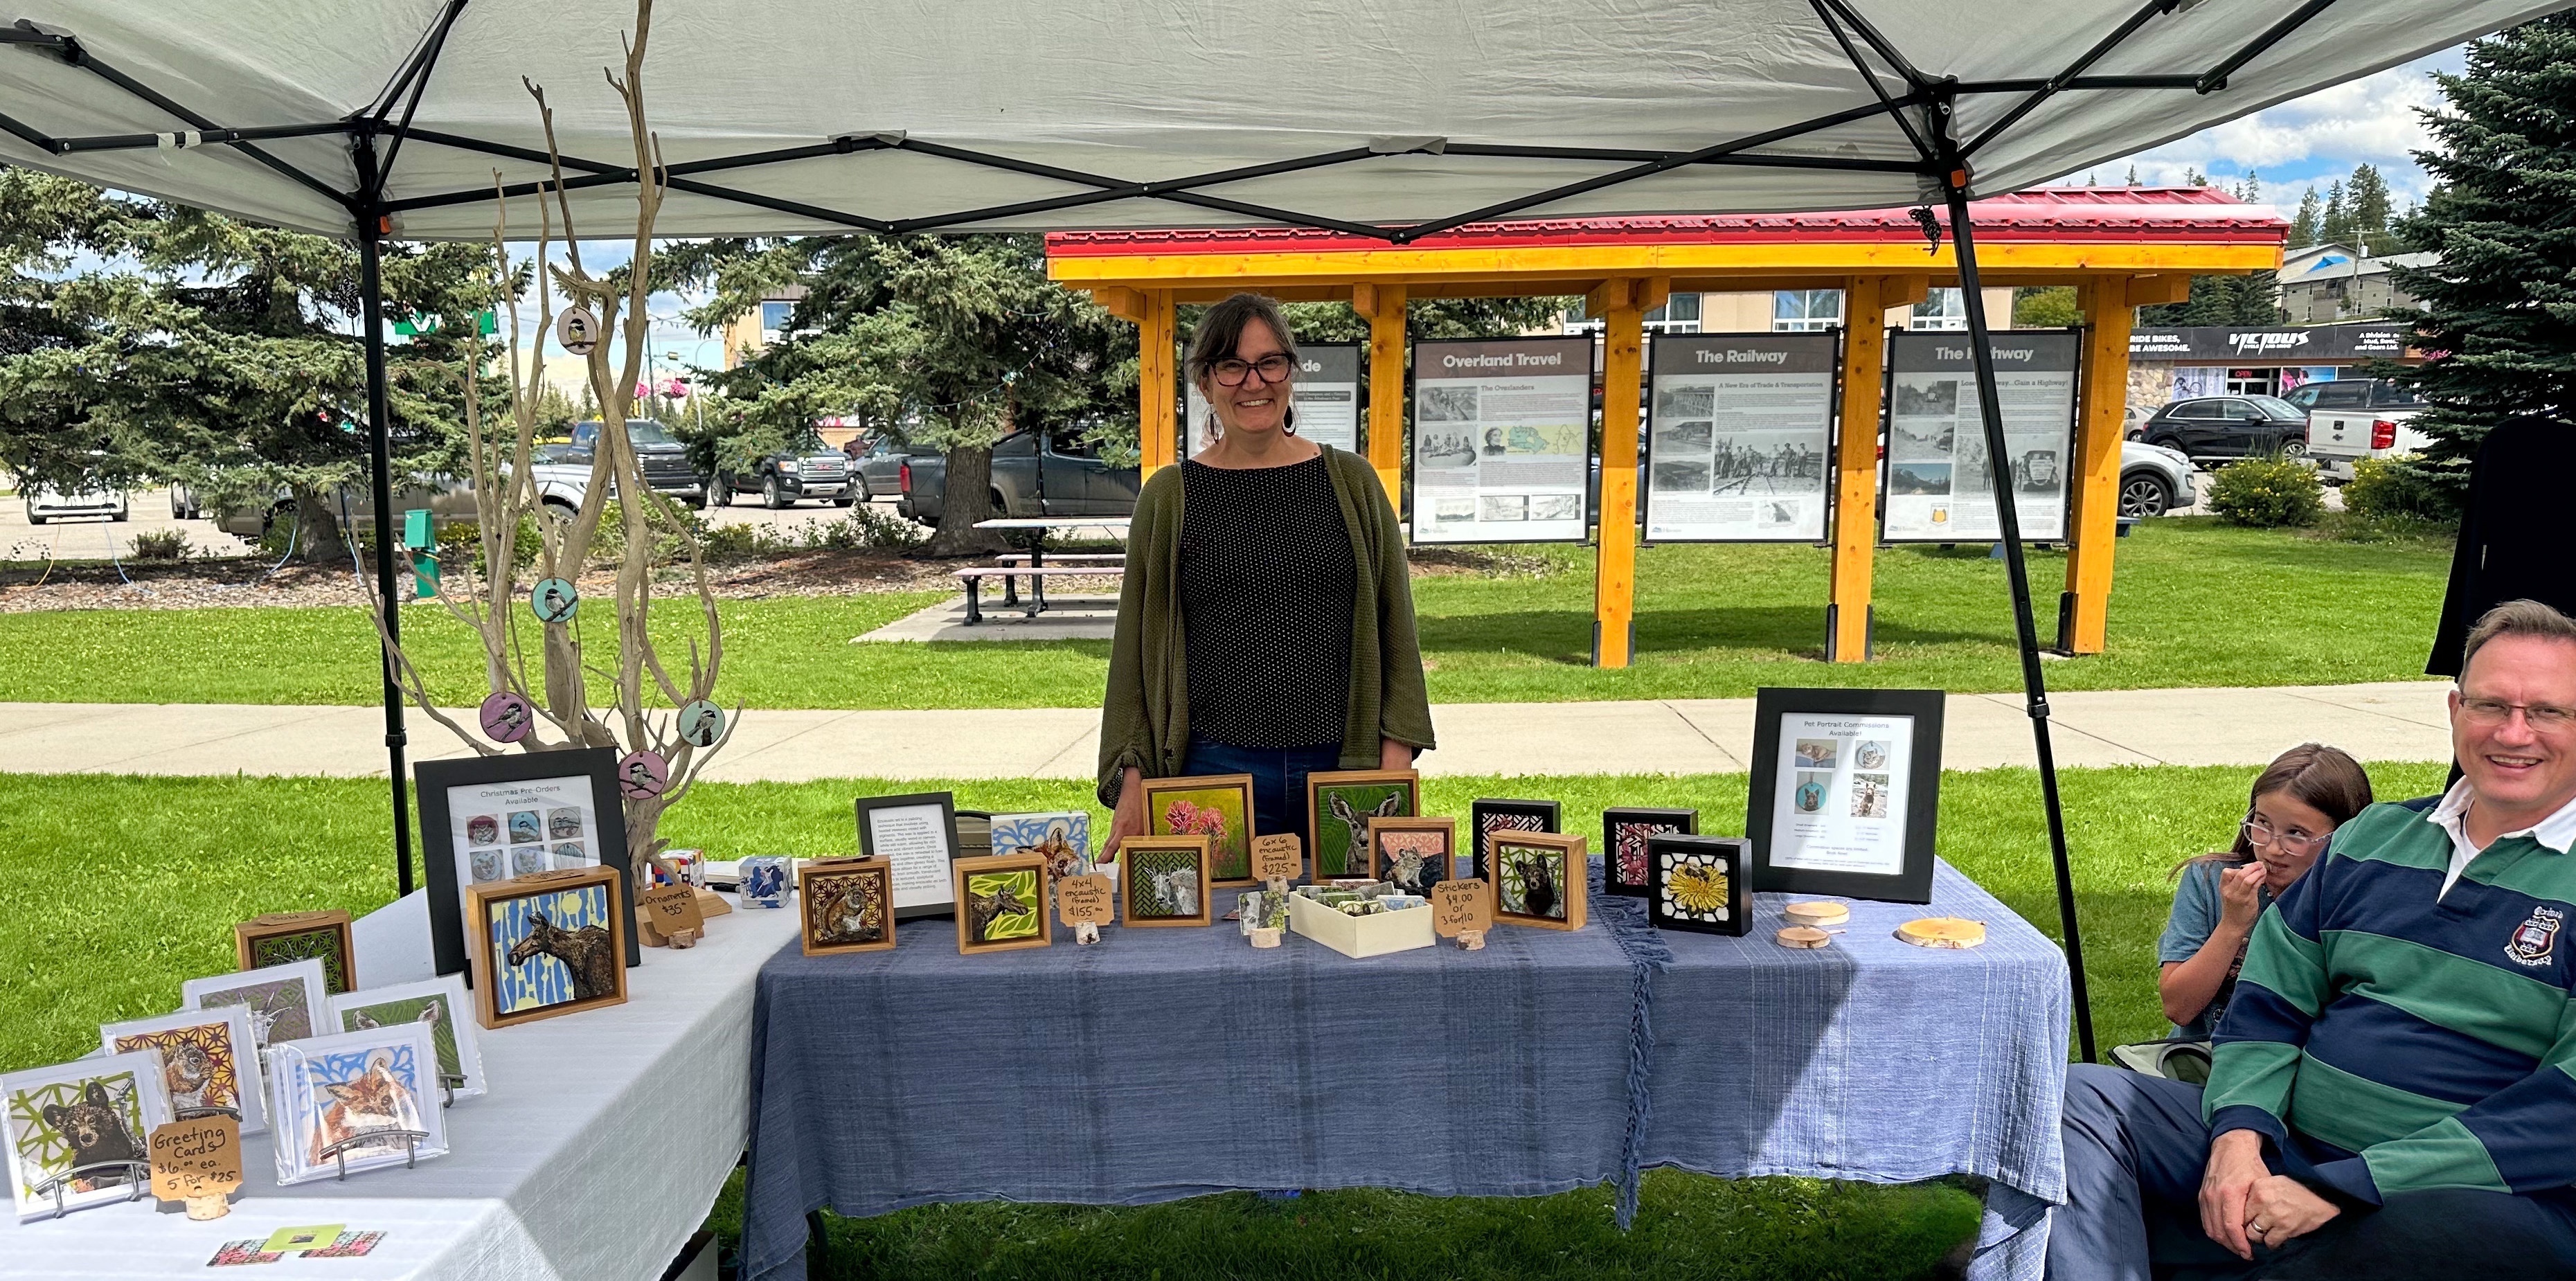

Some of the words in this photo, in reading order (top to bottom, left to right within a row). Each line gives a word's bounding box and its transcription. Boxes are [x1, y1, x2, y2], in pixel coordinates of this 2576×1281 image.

[2152, 334, 2181, 343] BIKES,
[2228, 330, 2311, 356] VICIOUS
[1696, 350, 1724, 363] The
[1727, 349, 1788, 364] Railway
[1935, 347, 1964, 359] The
[1442, 354, 1513, 368] Overland
[1516, 352, 1562, 366] Travel
[481, 789, 519, 798] Christmas
[521, 785, 561, 794] Pre-Orders
[505, 797, 539, 805] Available
[1259, 843, 1297, 854] encaustic
[1071, 877, 1092, 888] 4x4
[1438, 881, 1481, 893] Stickers
[645, 889, 692, 904] Ornaments
[1065, 886, 1107, 897] encaustic
[1453, 904, 1464, 913] or
[1441, 915, 1448, 925] 3
[154, 1127, 226, 1149] Greeting
[173, 1141, 217, 1158] Cards
[200, 1160, 221, 1169] ea.
[167, 1177, 181, 1190] 5
[210, 1170, 237, 1183] $25
